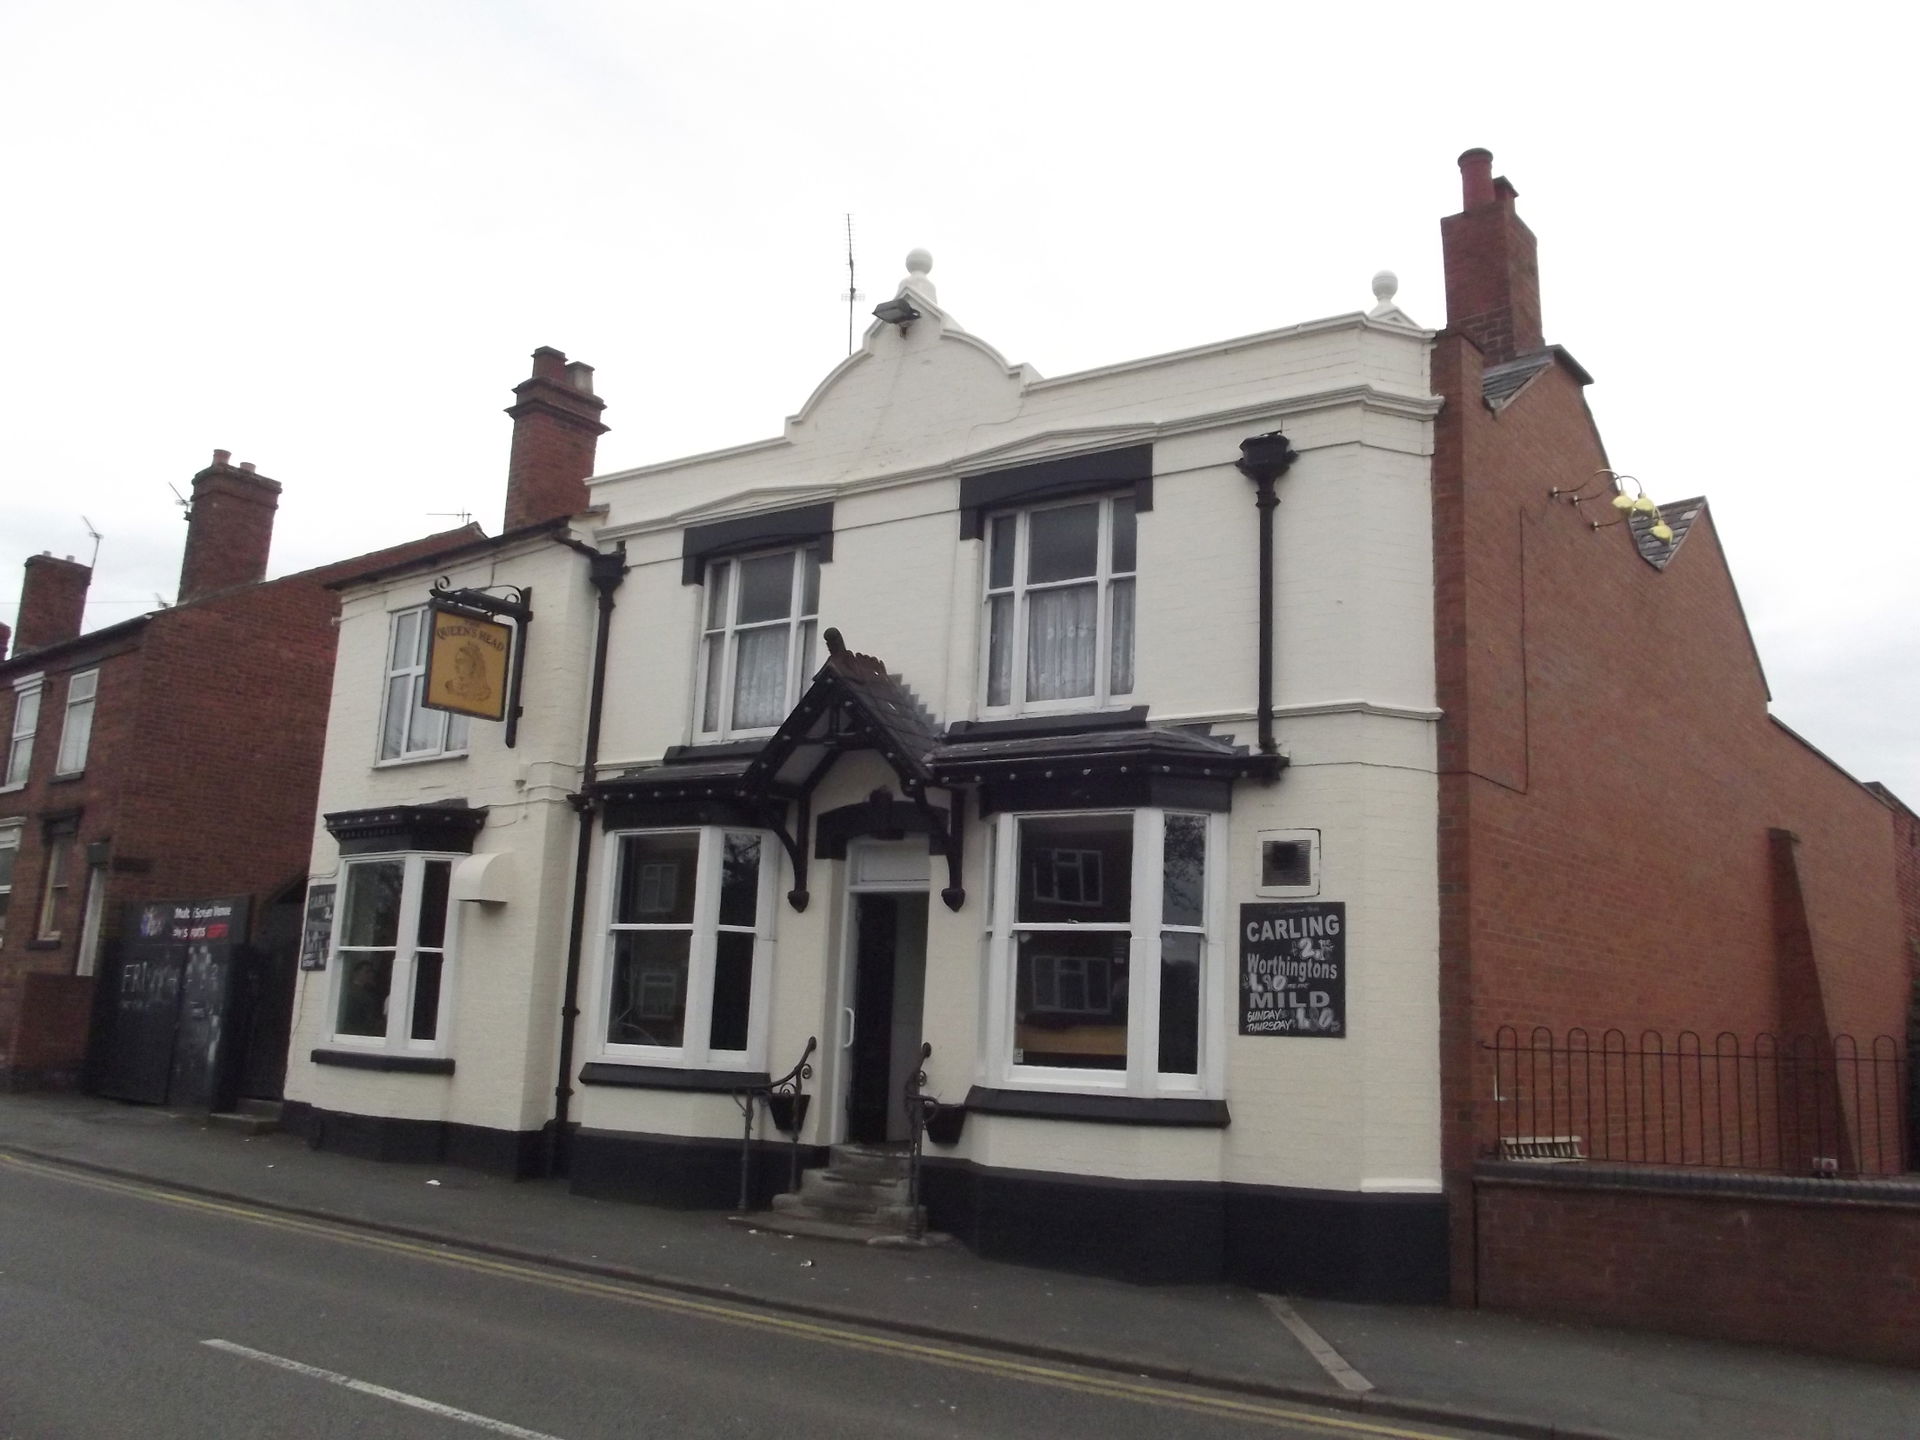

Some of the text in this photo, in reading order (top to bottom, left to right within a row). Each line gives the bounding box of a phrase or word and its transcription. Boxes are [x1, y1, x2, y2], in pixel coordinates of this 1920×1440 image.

[480, 630, 504, 651] HEAD
[1246, 914, 1340, 942] CARLING
[1247, 953, 1338, 983] Worthingtons
[1249, 991, 1330, 1009] MILD
[1247, 1009, 1282, 1022] SUNDAY
[1247, 1020, 1291, 1032] THURSDAY
